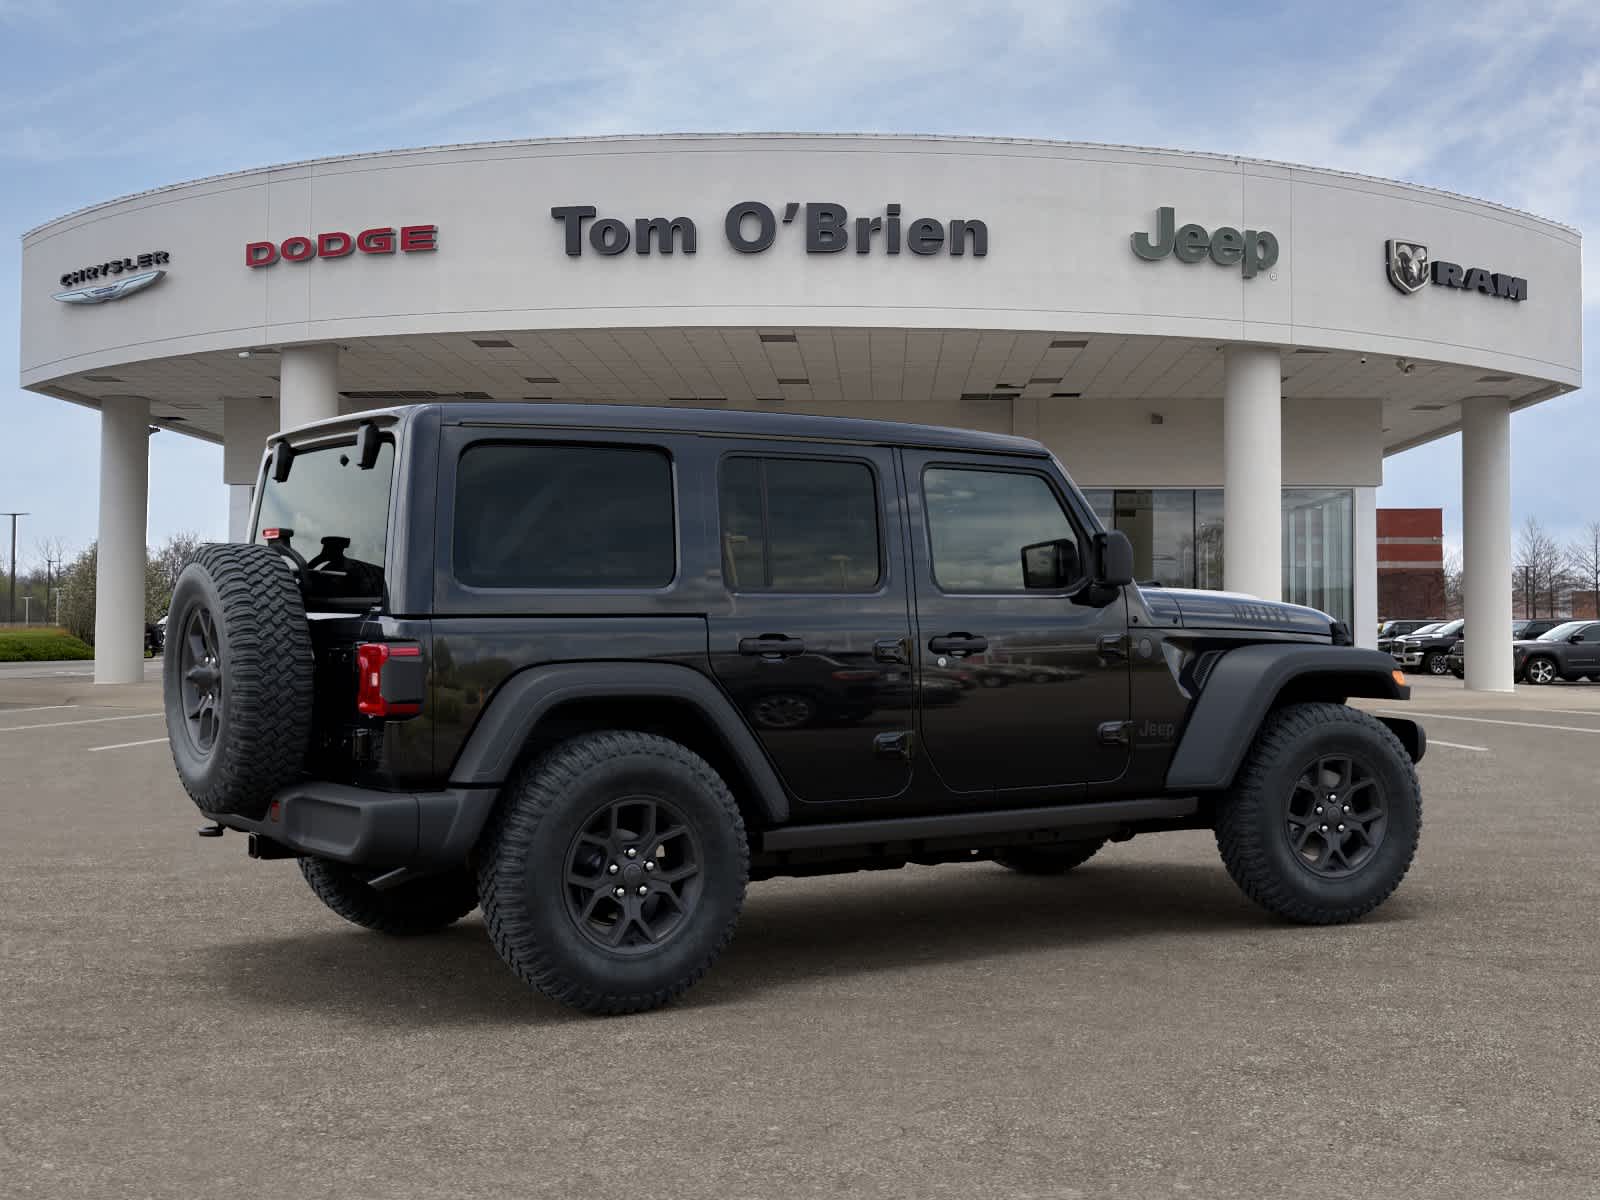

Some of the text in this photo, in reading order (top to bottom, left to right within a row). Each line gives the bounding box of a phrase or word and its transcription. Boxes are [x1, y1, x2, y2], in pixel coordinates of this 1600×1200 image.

[245, 224, 438, 269] DODGE
[551, 200, 988, 256] Tom O'Brien
[1130, 206, 1279, 279] Jeep
[60, 250, 170, 287] CHRYSLER
[1431, 260, 1527, 302] RAM
